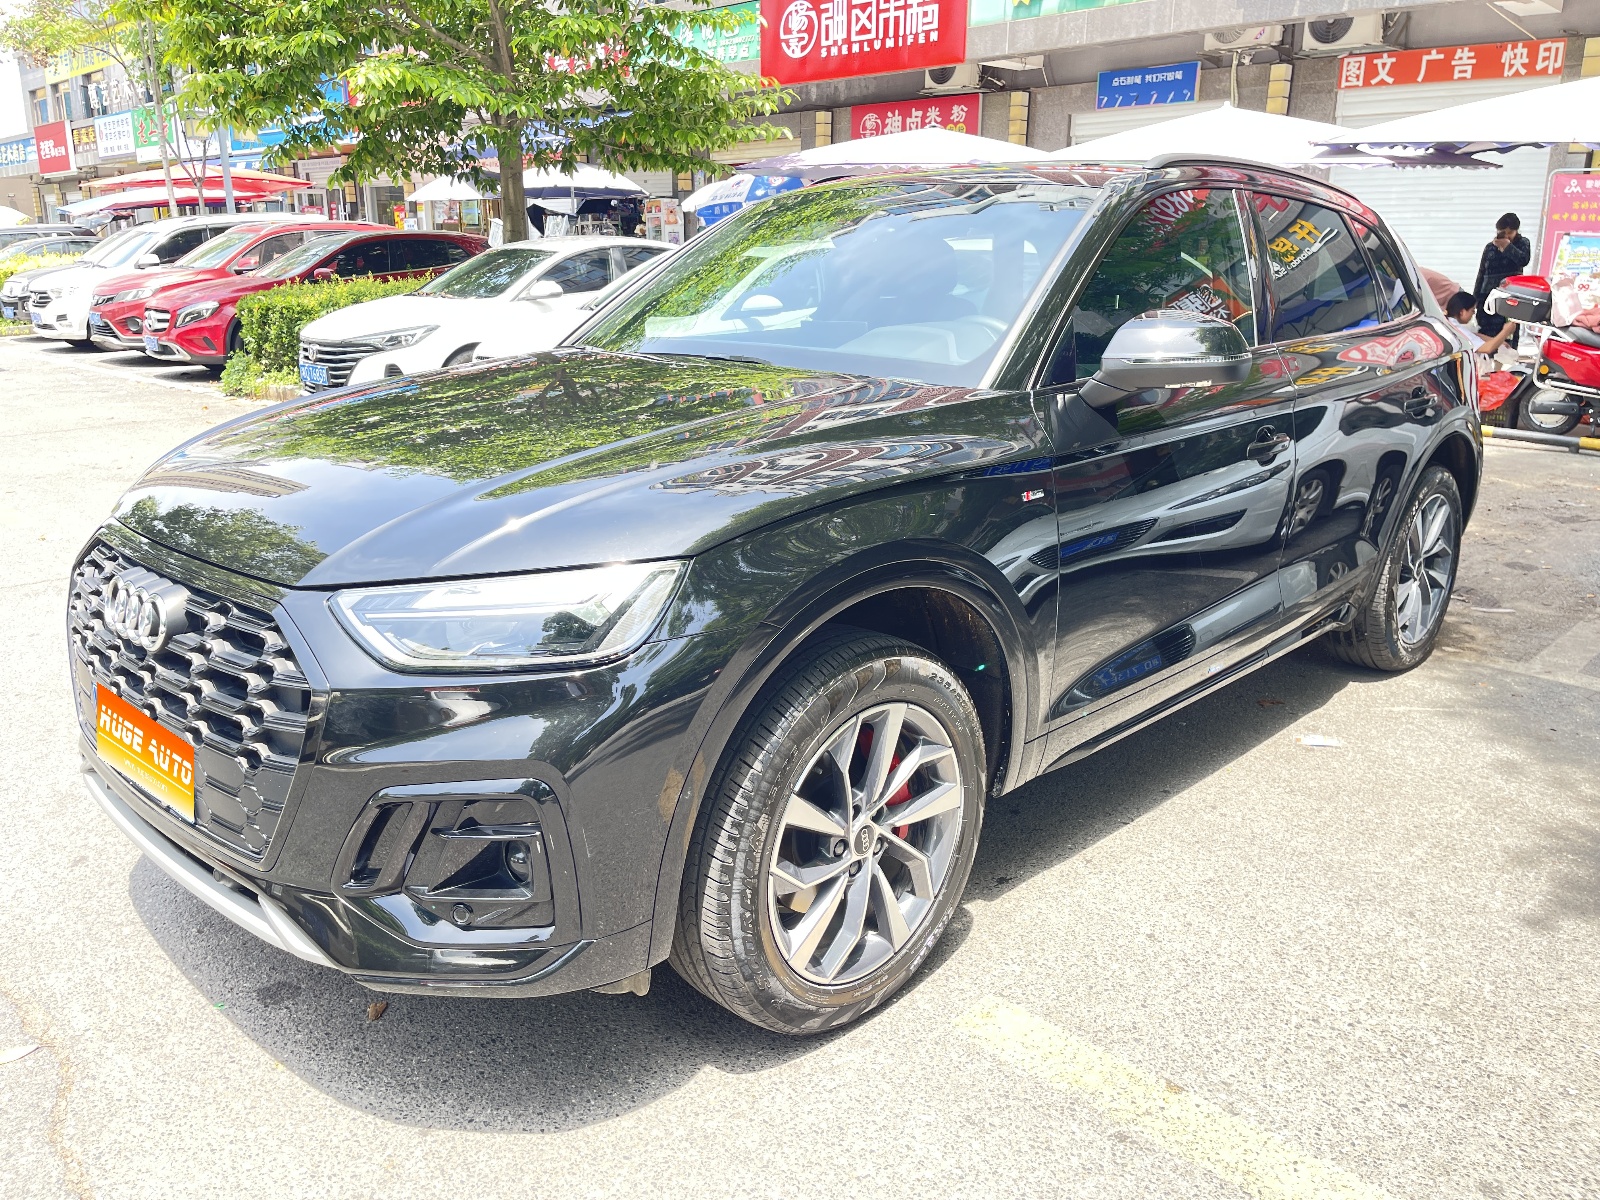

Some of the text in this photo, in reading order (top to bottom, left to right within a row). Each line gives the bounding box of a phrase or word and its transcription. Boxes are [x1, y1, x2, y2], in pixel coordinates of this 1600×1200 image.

[820, 30, 939, 58] SHENLUMIFEN
[1340, 41, 1565, 88] 图文 广告 快印
